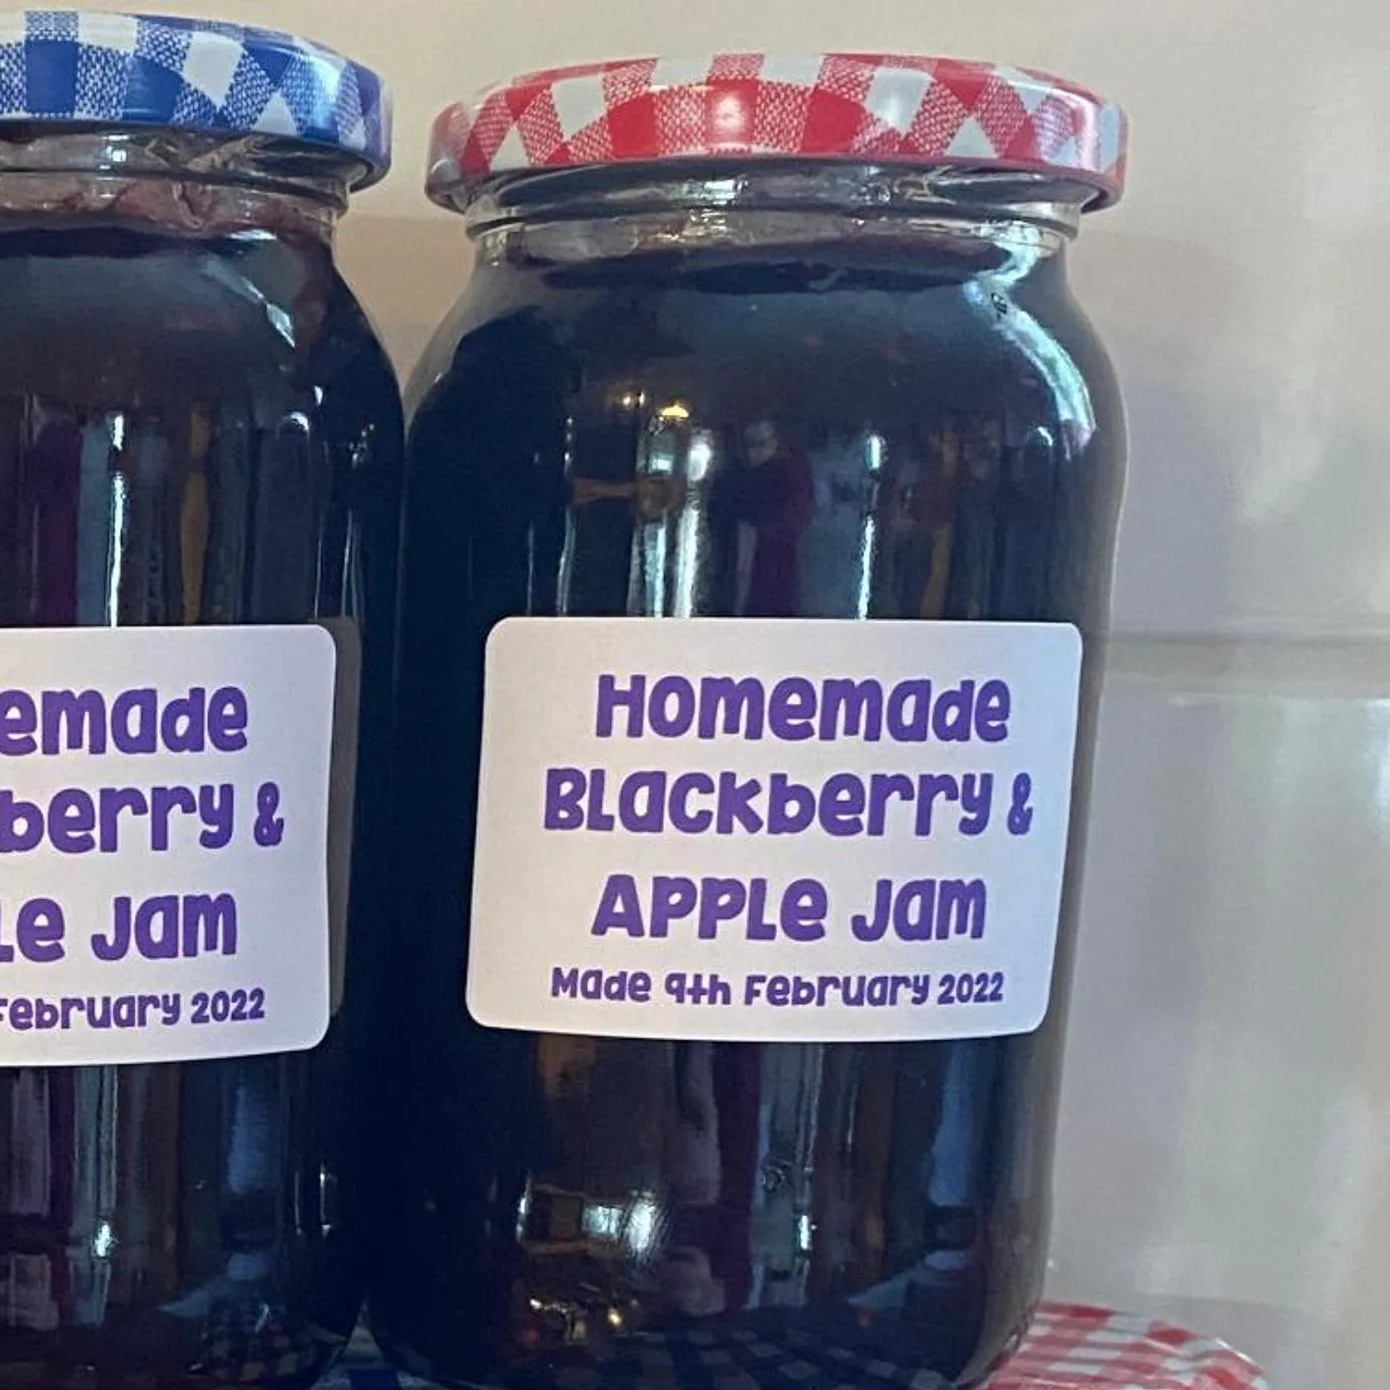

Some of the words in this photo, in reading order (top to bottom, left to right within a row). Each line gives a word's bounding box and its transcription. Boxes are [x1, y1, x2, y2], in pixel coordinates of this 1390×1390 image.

[596, 674, 1011, 743] Homemade
[253, 781, 285, 848] &
[1006, 771, 1034, 837] &
[91, 892, 238, 961] Jam
[851, 878, 987, 942] Jam
[191, 987, 265, 1024] 2022
[552, 967, 651, 1002] Made
[666, 973, 731, 1005] 9th
[745, 974, 930, 1007] February
[937, 971, 1005, 1005] 2022
